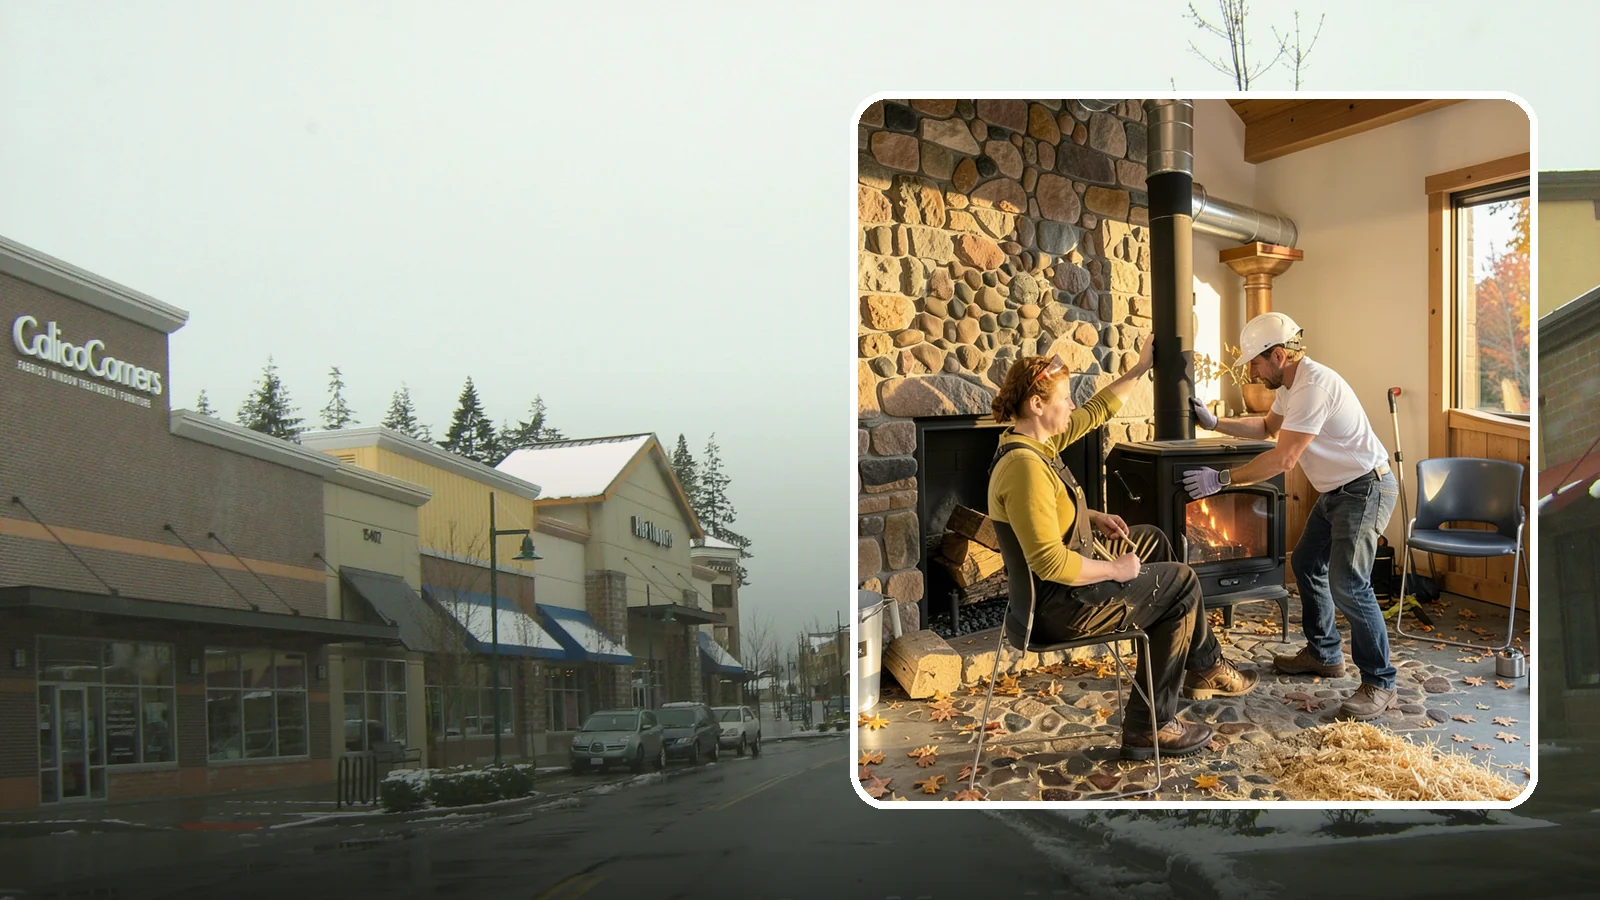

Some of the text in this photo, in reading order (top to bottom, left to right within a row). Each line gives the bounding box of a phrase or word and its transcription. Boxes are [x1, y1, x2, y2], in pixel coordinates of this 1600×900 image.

[16, 360, 46, 377] FABRICS
[51, 370, 78, 386] WINDOW
[78, 379, 116, 398] TREATMENTS
[119, 391, 151, 408] FURNITURE
